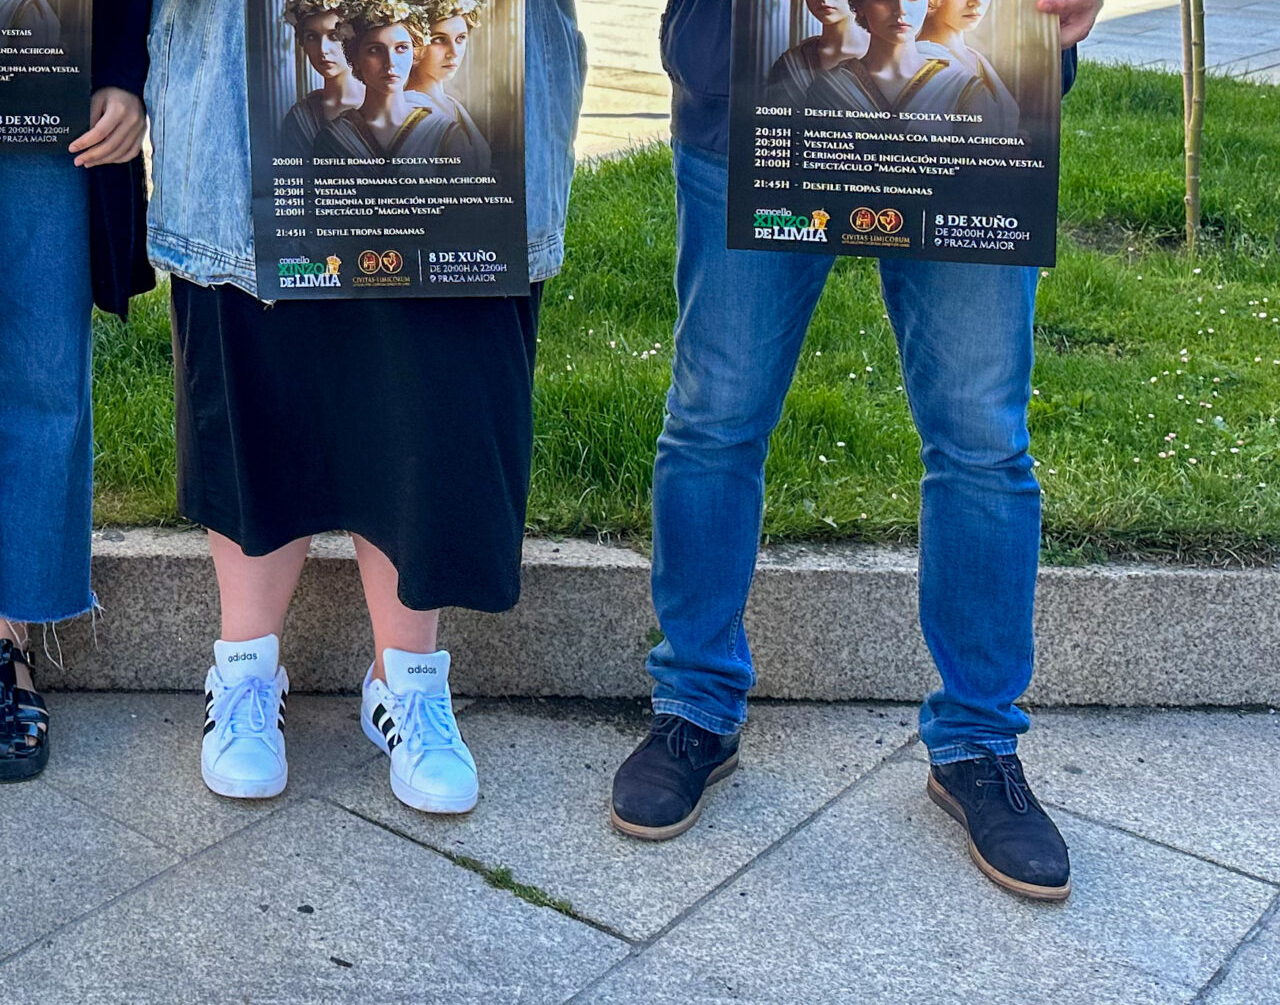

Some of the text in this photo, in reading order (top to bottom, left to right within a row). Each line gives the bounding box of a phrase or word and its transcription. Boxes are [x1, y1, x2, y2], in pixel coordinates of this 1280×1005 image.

[5, 115, 20, 124] DE
[23, 113, 59, 125] XUÑO
[755, 106, 982, 122] 20:00H DESFILE ROMANO ESCOLTA VESTAIS
[755, 127, 1024, 146] 20:15H MARCHAS ROMANAS COA BANDA ACHICORIA
[755, 137, 855, 149] 20:30H VESTALIAS
[754, 158, 790, 167] 21:00H
[803, 160, 872, 172] ESPECTÁCULO
[755, 148, 1044, 168] 20:45H CERIMONIA DE INICIACIÓN DUNHA NOVA VESTAL
[754, 179, 932, 195] 21:45H DESFILE TROPAS ROMANAS
[755, 206, 792, 216] concello
[753, 213, 809, 229] XINZO
[935, 213, 1018, 229] 8 DE XUÑO
[755, 225, 827, 242] DE LIMIA
[935, 227, 1029, 240] DE 20:00H A 22:00H
[944, 238, 1014, 250] PRAZA MAIOR
[278, 255, 309, 264] concello
[428, 249, 496, 262] 8 DE XUÑO
[277, 262, 325, 276] XINZO
[279, 273, 341, 287] DE LIMIA
[227, 651, 258, 664] adidas
[407, 665, 438, 675] adidas
